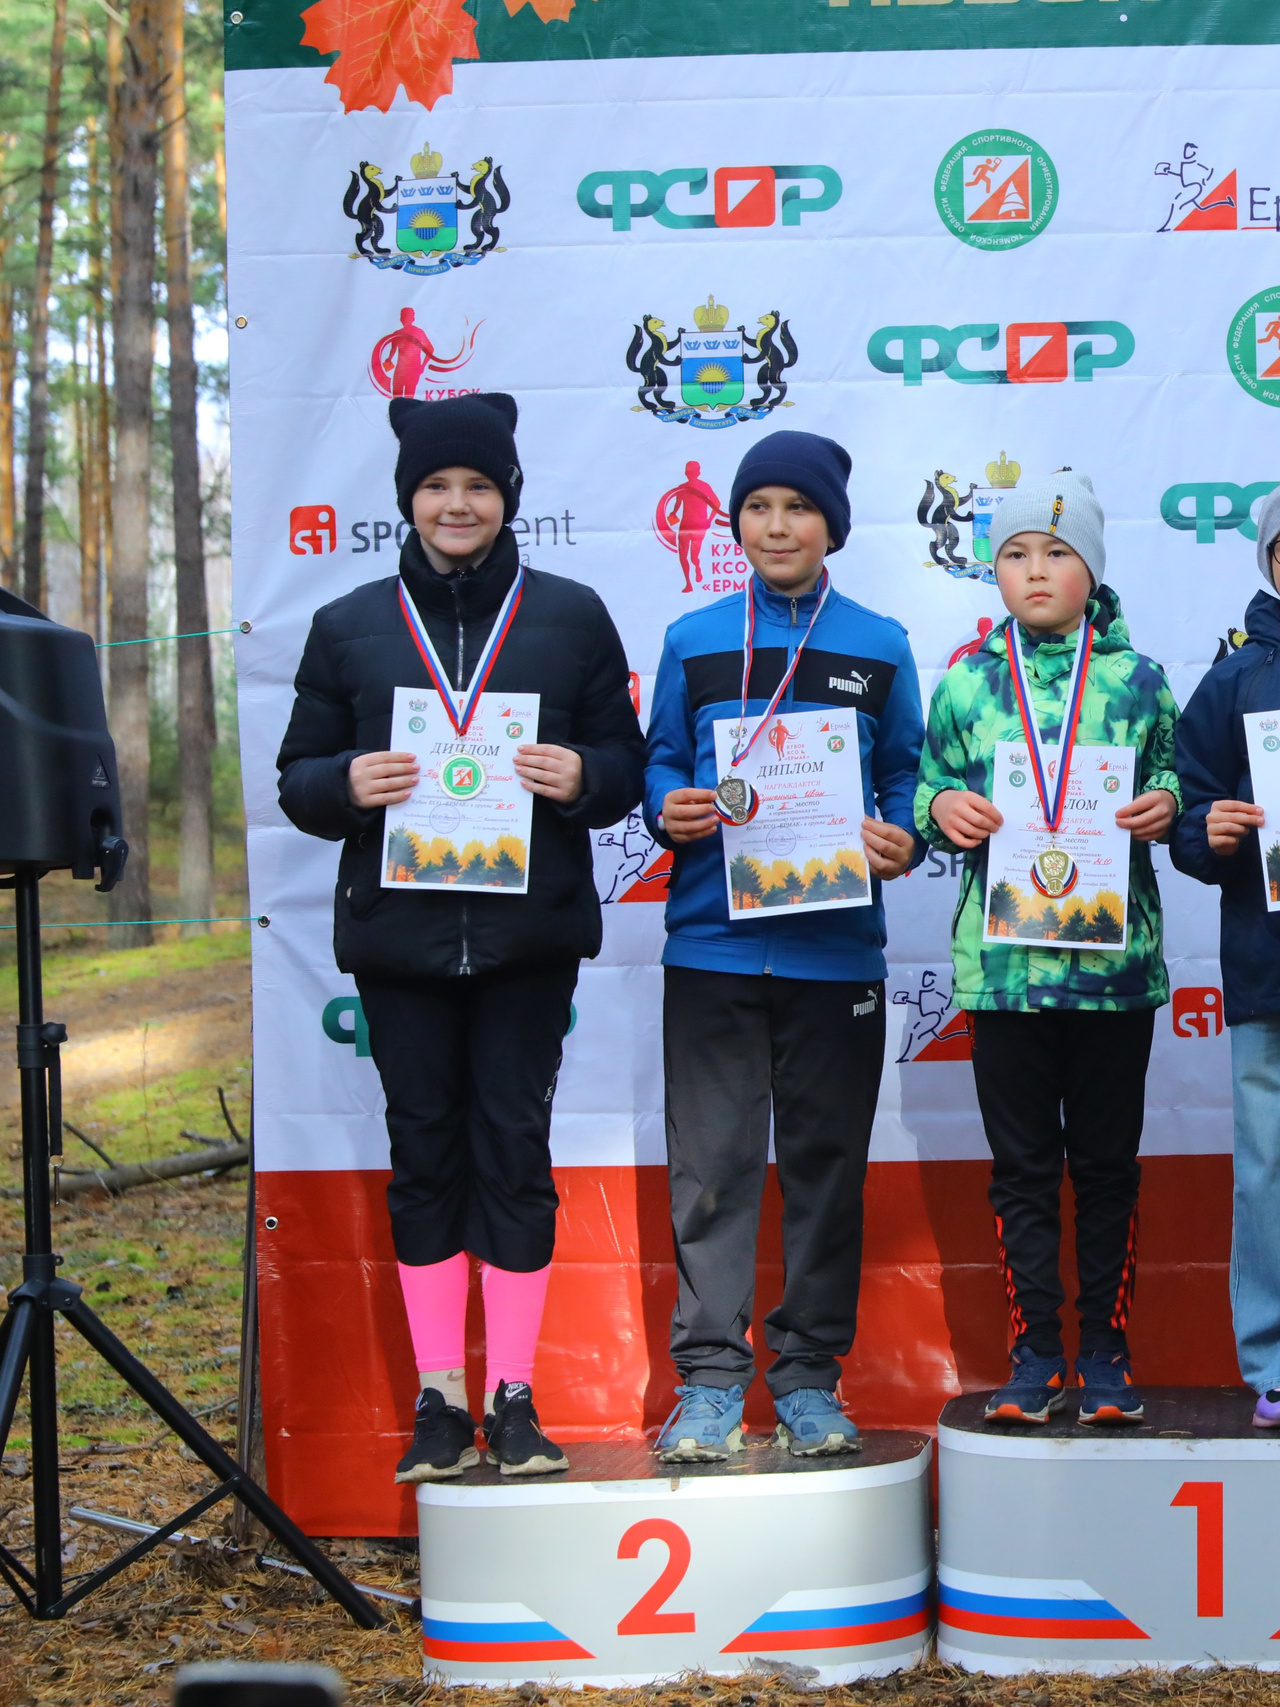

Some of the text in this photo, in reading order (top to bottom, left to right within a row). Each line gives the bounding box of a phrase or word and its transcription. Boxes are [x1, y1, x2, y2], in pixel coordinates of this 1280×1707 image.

[941, 135, 1052, 245] ФЕДЕРАЦИЯ СПОРТИВНОГО ОРИЕНТИРОВАНИЯ ТЮМЕНСКОЙ ОБЛАСТИ
[379, 254, 472, 274] СИБИРЬЮ ПРИРАСТАТЬ БУДЕТ
[1233, 302, 1260, 348] ФЕДЕРАЦИЯ
[1234, 354, 1257, 389] ОБЛАСТИ
[663, 408, 759, 427] СИБИРЬЮ ПРИРАСТАТЬ БУДЕТ
[711, 563, 746, 574] КСО
[829, 676, 863, 695] PUMA
[757, 761, 824, 779] ДИПЛОМ
[764, 780, 821, 790] НАГРАЖДАЕТСЯ
[1031, 797, 1098, 810] ДЛОМ
[1052, 880, 1059, 892] 1
[853, 1000, 875, 1016] PUMA
[1172, 1481, 1223, 1618] 1
[616, 1518, 695, 1636] 2
